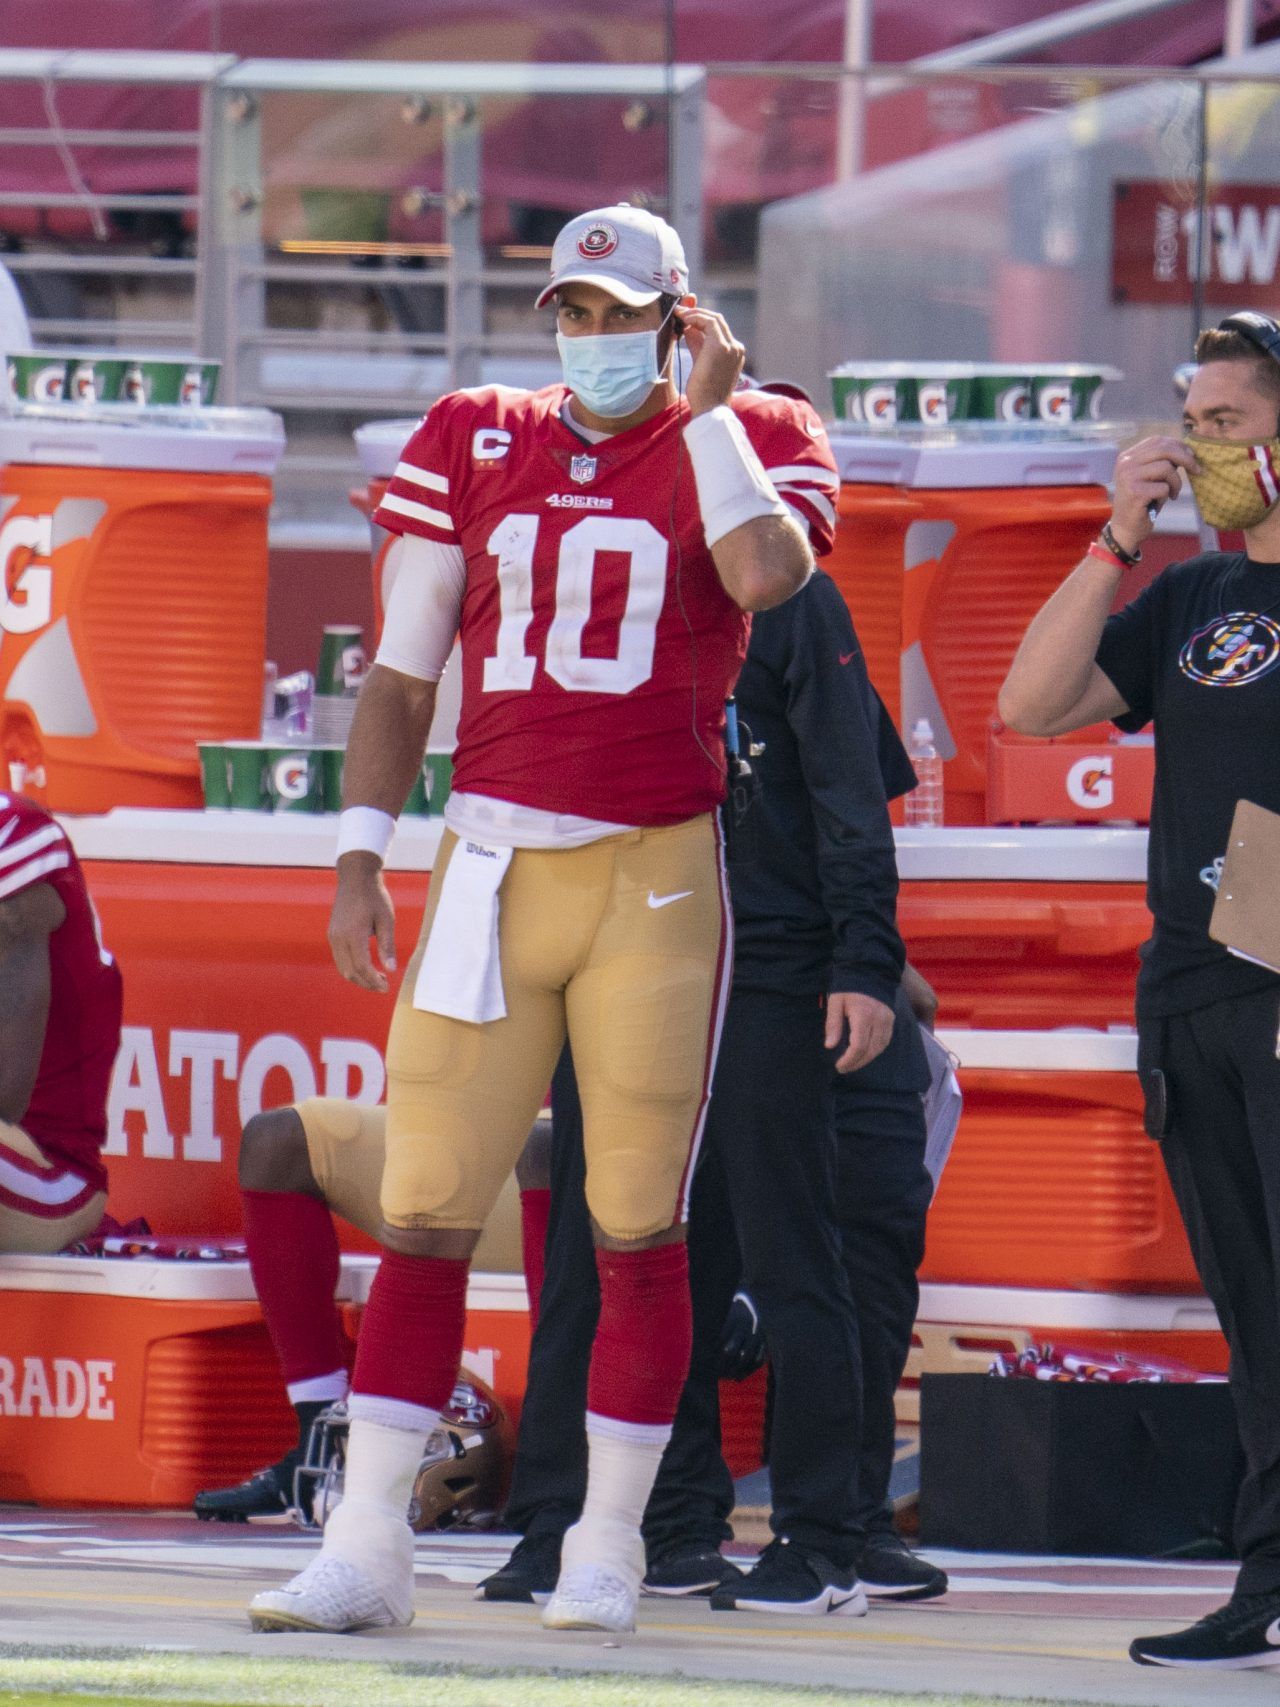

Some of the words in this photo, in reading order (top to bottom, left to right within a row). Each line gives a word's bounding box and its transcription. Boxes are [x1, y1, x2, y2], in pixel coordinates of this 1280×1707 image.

[1154, 203, 1178, 282] ROW
[864, 386, 897, 425] G
[918, 384, 949, 425] G
[1039, 385, 1071, 425] G
[472, 428, 513, 460] C
[545, 493, 614, 511] 49ERS
[482, 513, 670, 695] 10
[274, 756, 309, 800] G
[1066, 755, 1114, 809] G
